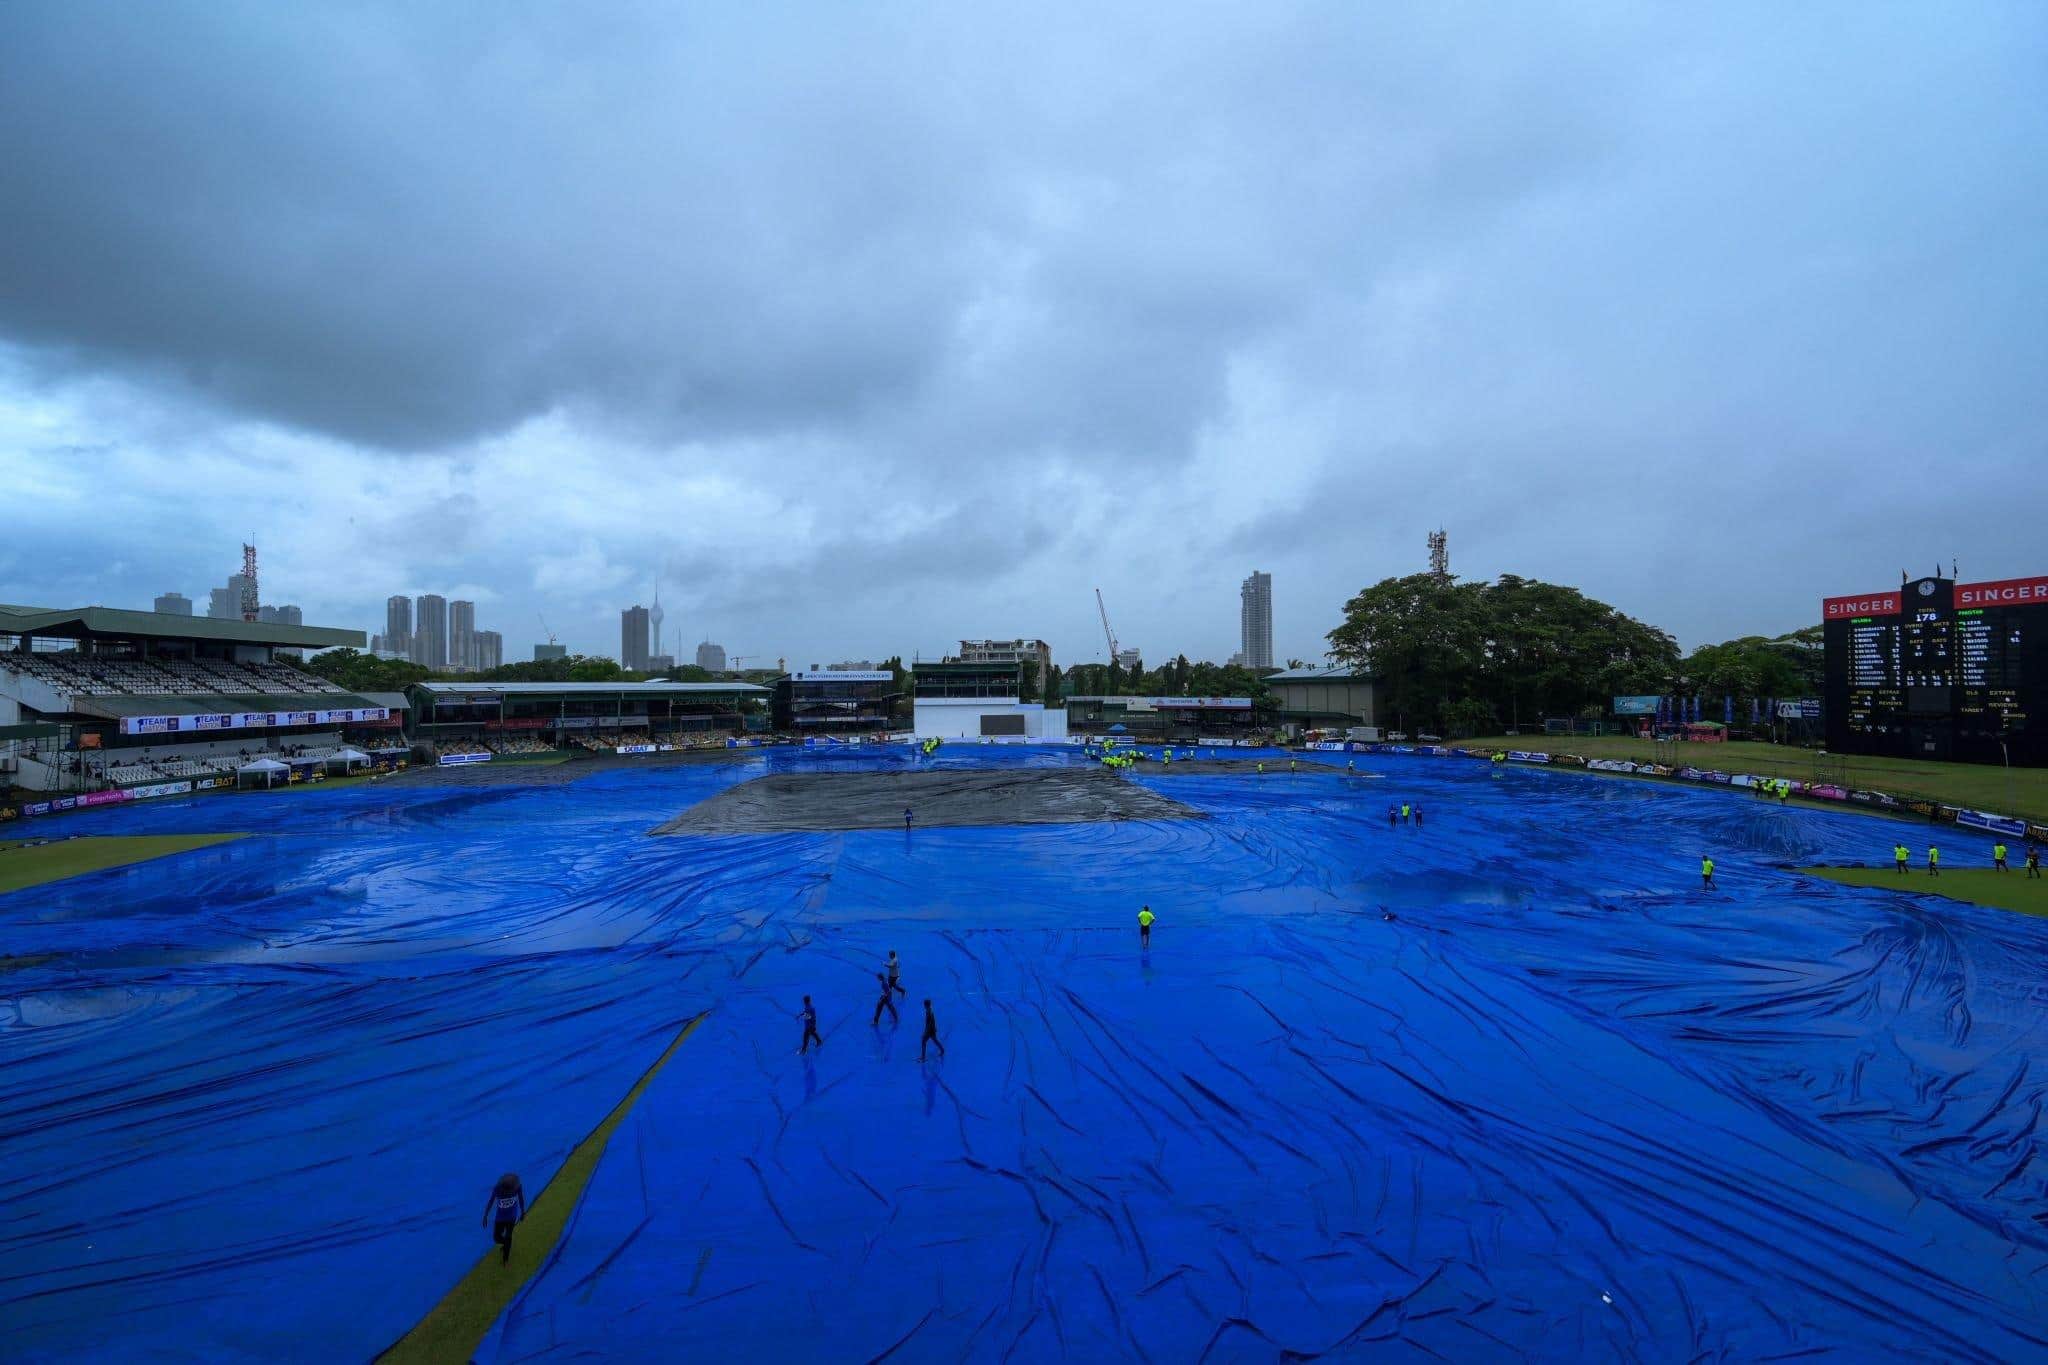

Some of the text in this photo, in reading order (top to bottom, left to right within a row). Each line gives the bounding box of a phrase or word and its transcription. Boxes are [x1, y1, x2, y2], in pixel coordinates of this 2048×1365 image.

[1962, 585, 2048, 603] SINGER
[1829, 600, 1894, 614] SINGER
[1916, 613, 1937, 622] 178
[143, 717, 166, 725] TEAM
[199, 715, 221, 723] TEAM
[248, 713, 266, 721] TEAM
[196, 776, 235, 790] MELBAT
